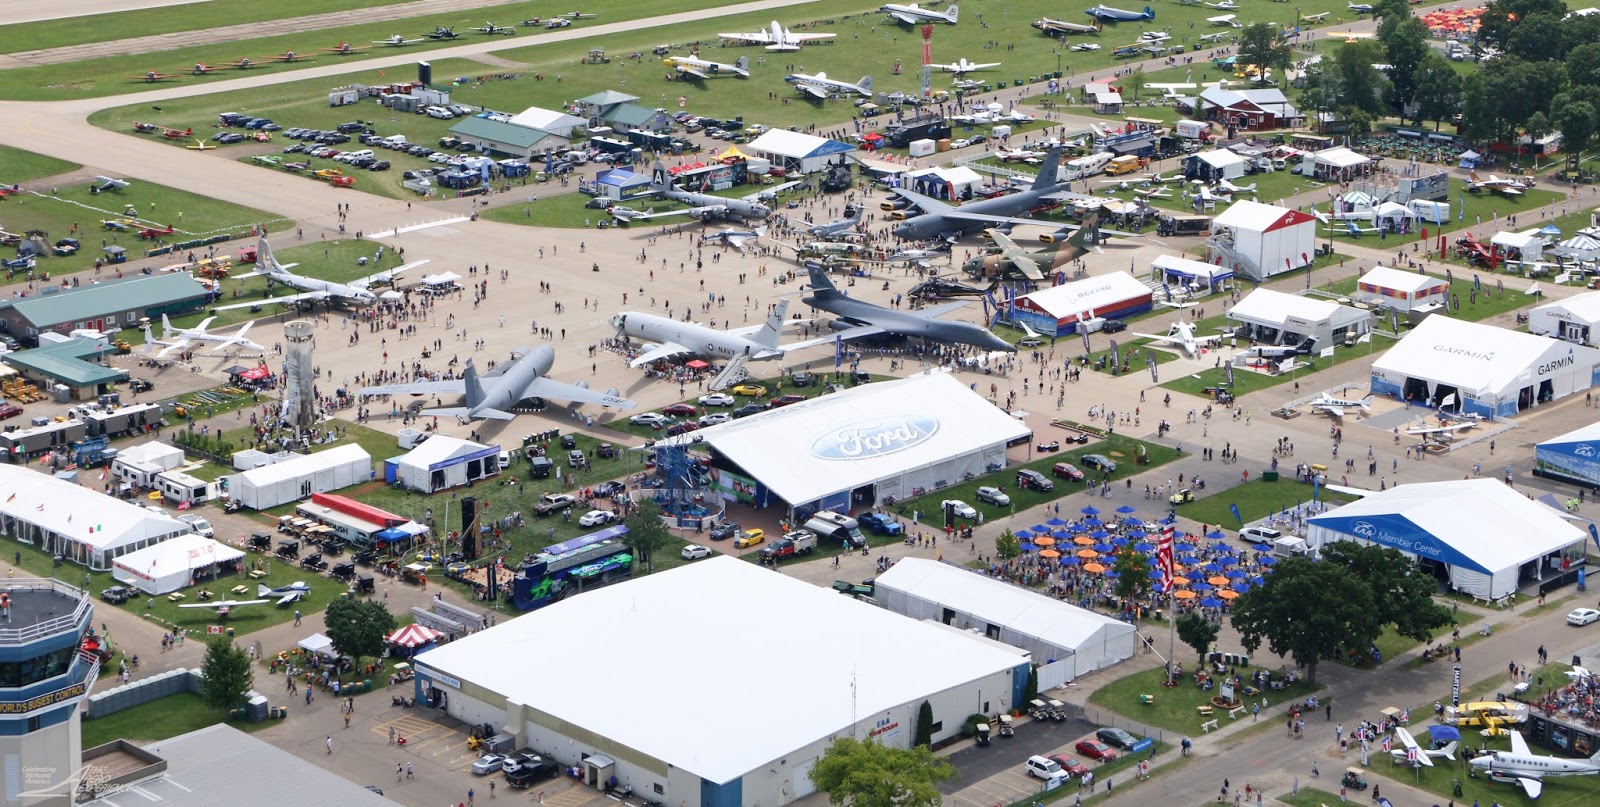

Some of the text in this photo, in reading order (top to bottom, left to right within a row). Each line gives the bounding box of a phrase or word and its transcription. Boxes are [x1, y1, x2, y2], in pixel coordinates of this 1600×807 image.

[654, 172, 663, 185] A
[1078, 284, 1112, 298] BOEING
[774, 311, 782, 321] LD
[1546, 311, 1571, 321] GARMIN
[718, 345, 736, 355] NAVY
[1433, 343, 1493, 362] GARMIN
[1537, 356, 1574, 376] GARMIN
[838, 420, 919, 456] Ford
[325, 520, 349, 535] ROUSH
[1377, 531, 1413, 548] Member
[1413, 541, 1442, 557] Center
[1453, 669, 1461, 703] HARTZELL
[28, 693, 55, 711] BUSIEST
[55, 684, 85, 702] CONTROL
[876, 717, 890, 728] EAA
